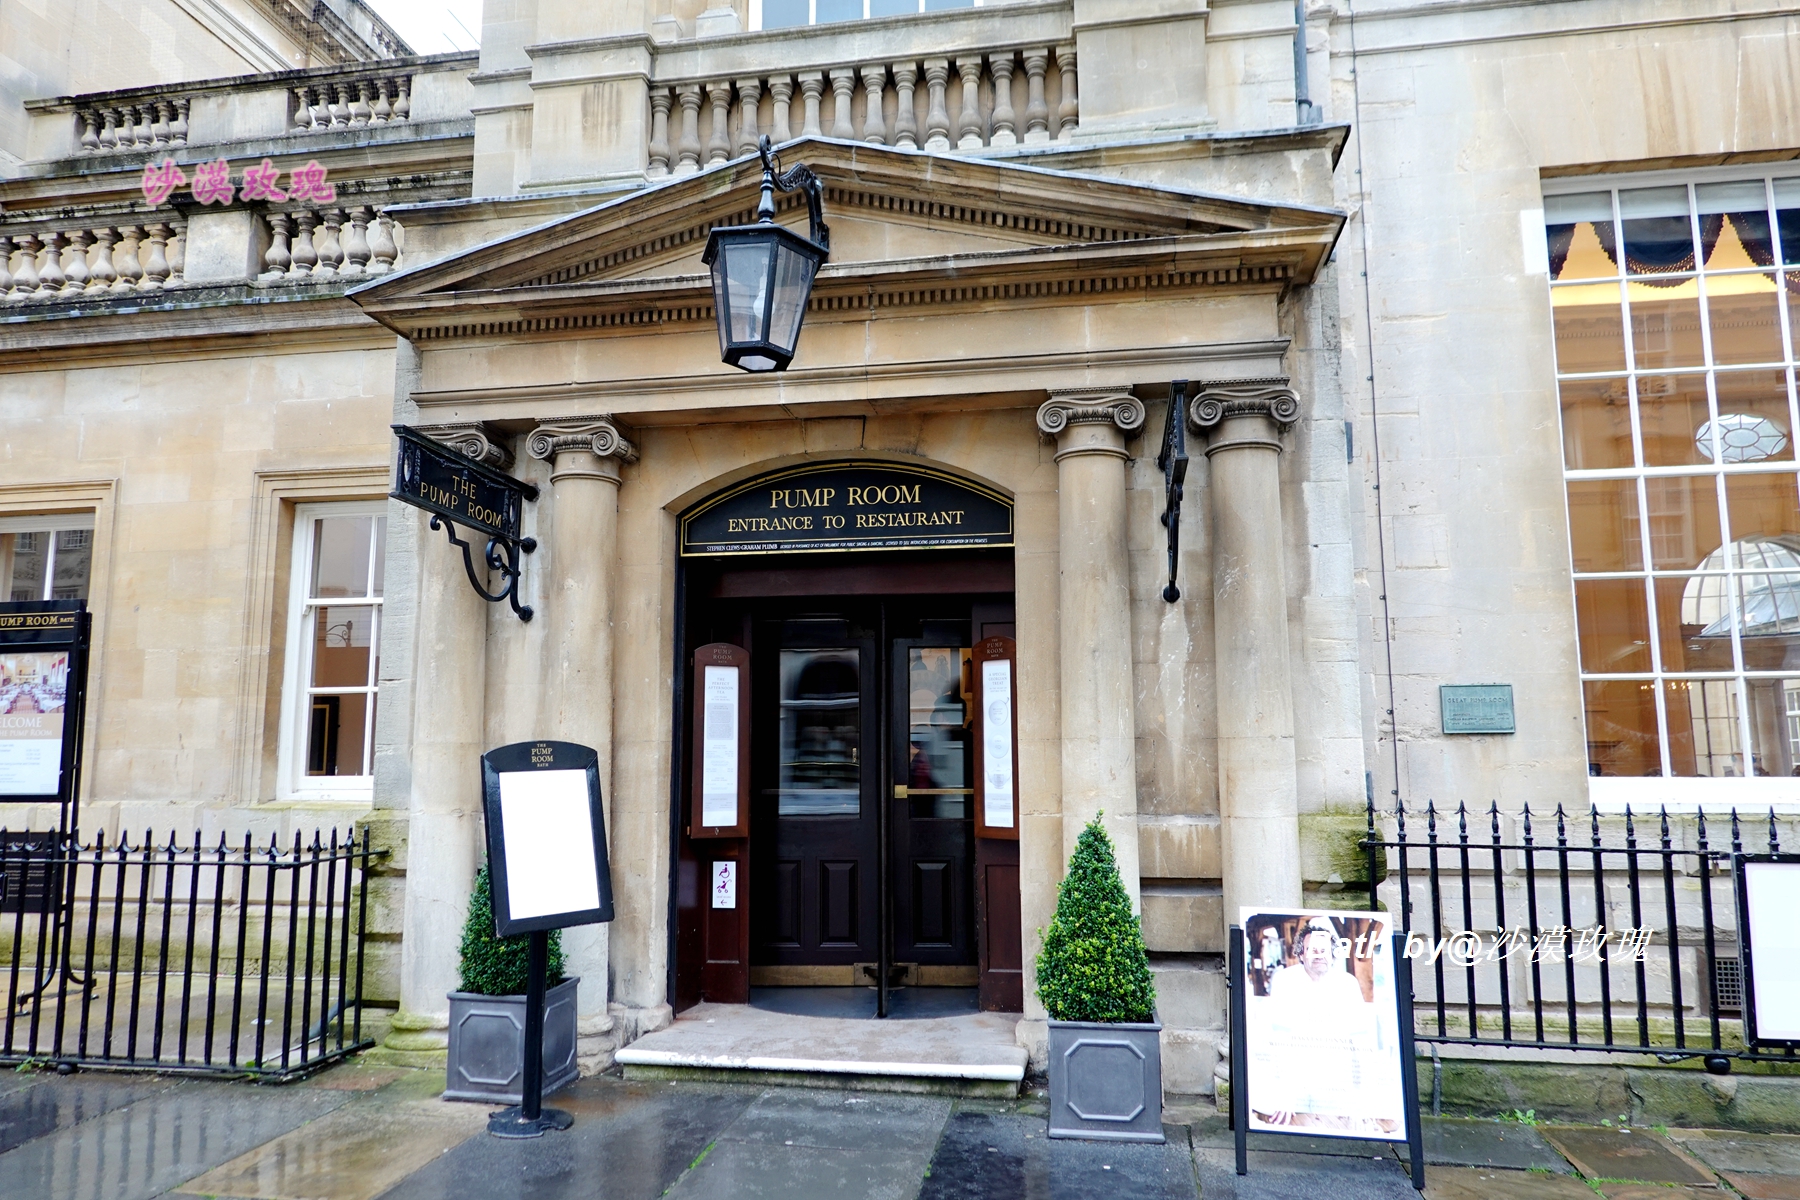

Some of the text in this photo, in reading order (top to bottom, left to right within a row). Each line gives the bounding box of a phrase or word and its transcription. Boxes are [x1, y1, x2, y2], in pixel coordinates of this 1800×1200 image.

[452, 475, 477, 500] THE
[769, 484, 922, 509] PUMP ROOM
[419, 482, 502, 529] PUMP ROOM
[728, 510, 965, 532] ENTRANCE TO RESTAURANT
[26, 615, 59, 626] ROOM
[30, 728, 53, 736] ROOM
[531, 747, 553, 755] PUMP
[531, 755, 554, 763] ROOM
